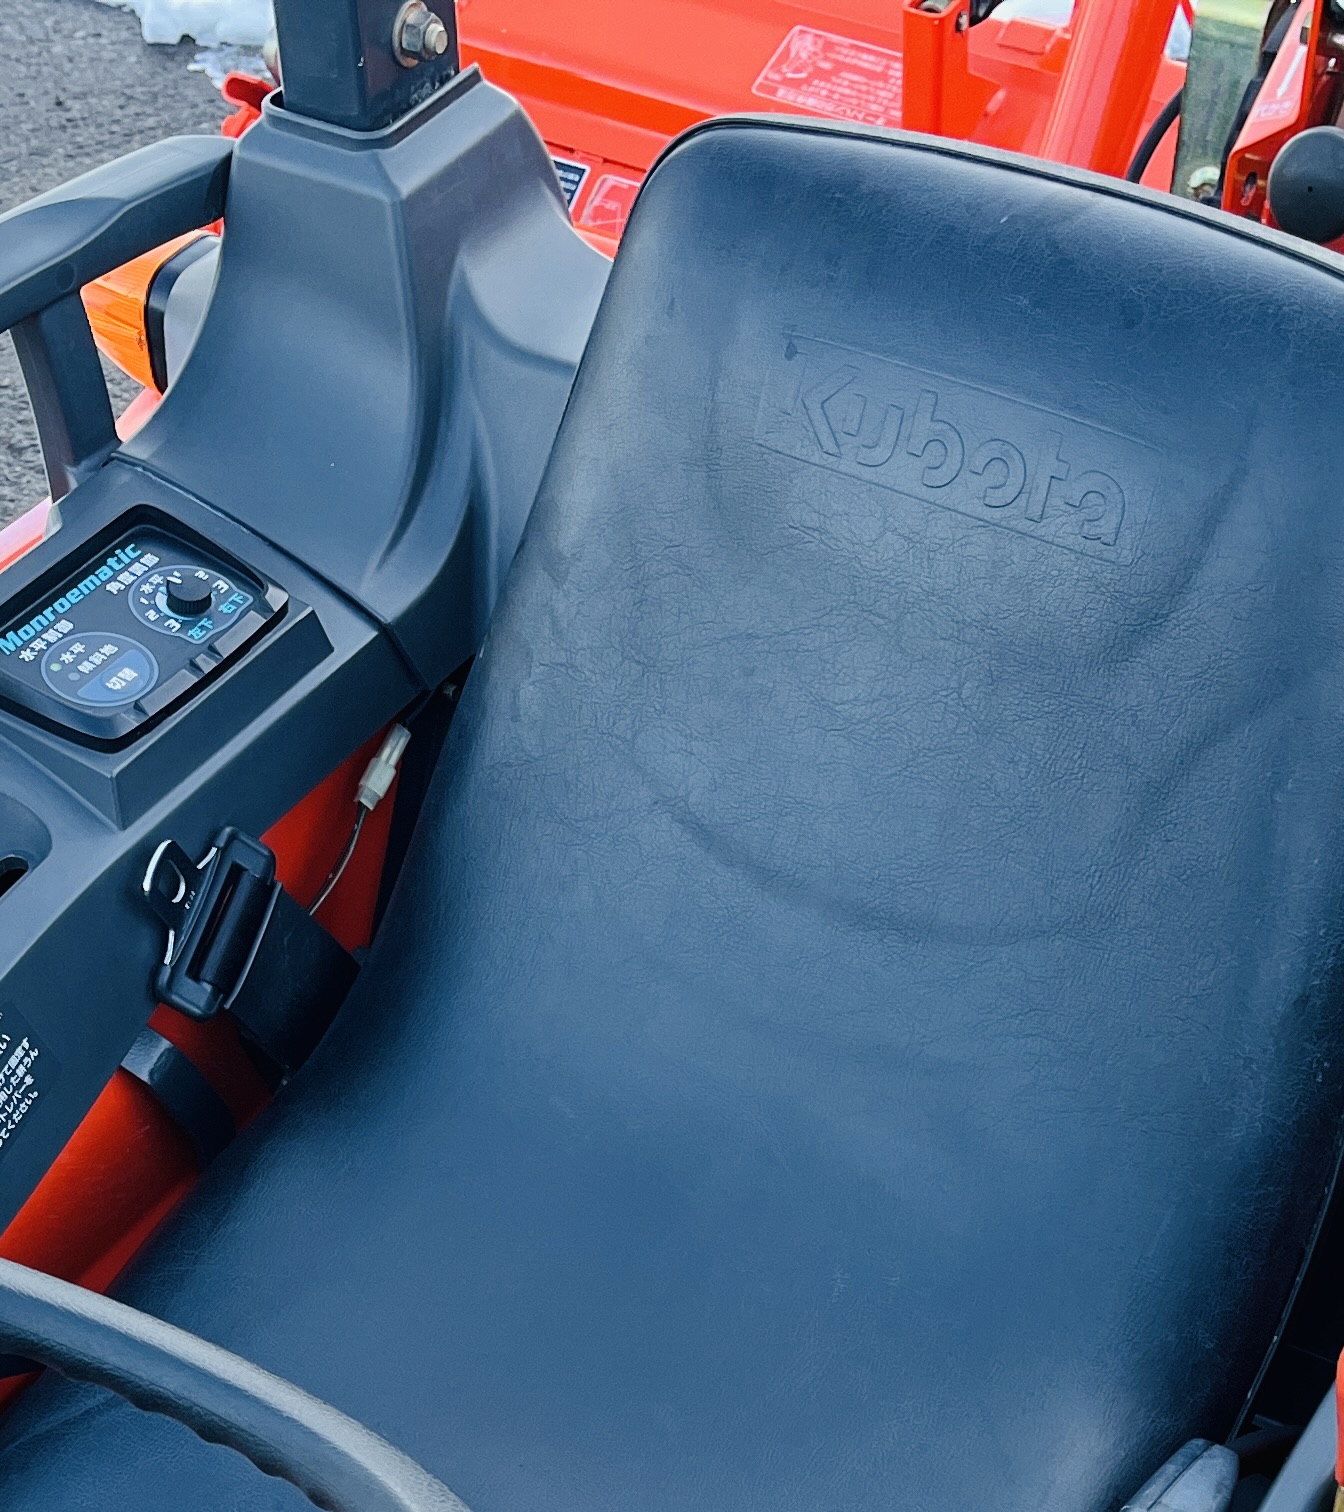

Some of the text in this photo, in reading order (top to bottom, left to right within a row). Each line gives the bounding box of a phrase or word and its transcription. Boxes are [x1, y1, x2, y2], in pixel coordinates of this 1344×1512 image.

[790, 353, 1126, 547] Kubota
[193, 569, 210, 582] 2
[212, 579, 230, 595] 3
[144, 608, 161, 622] 2
[163, 617, 181, 634] 3
[59, 641, 86, 664] 水平
